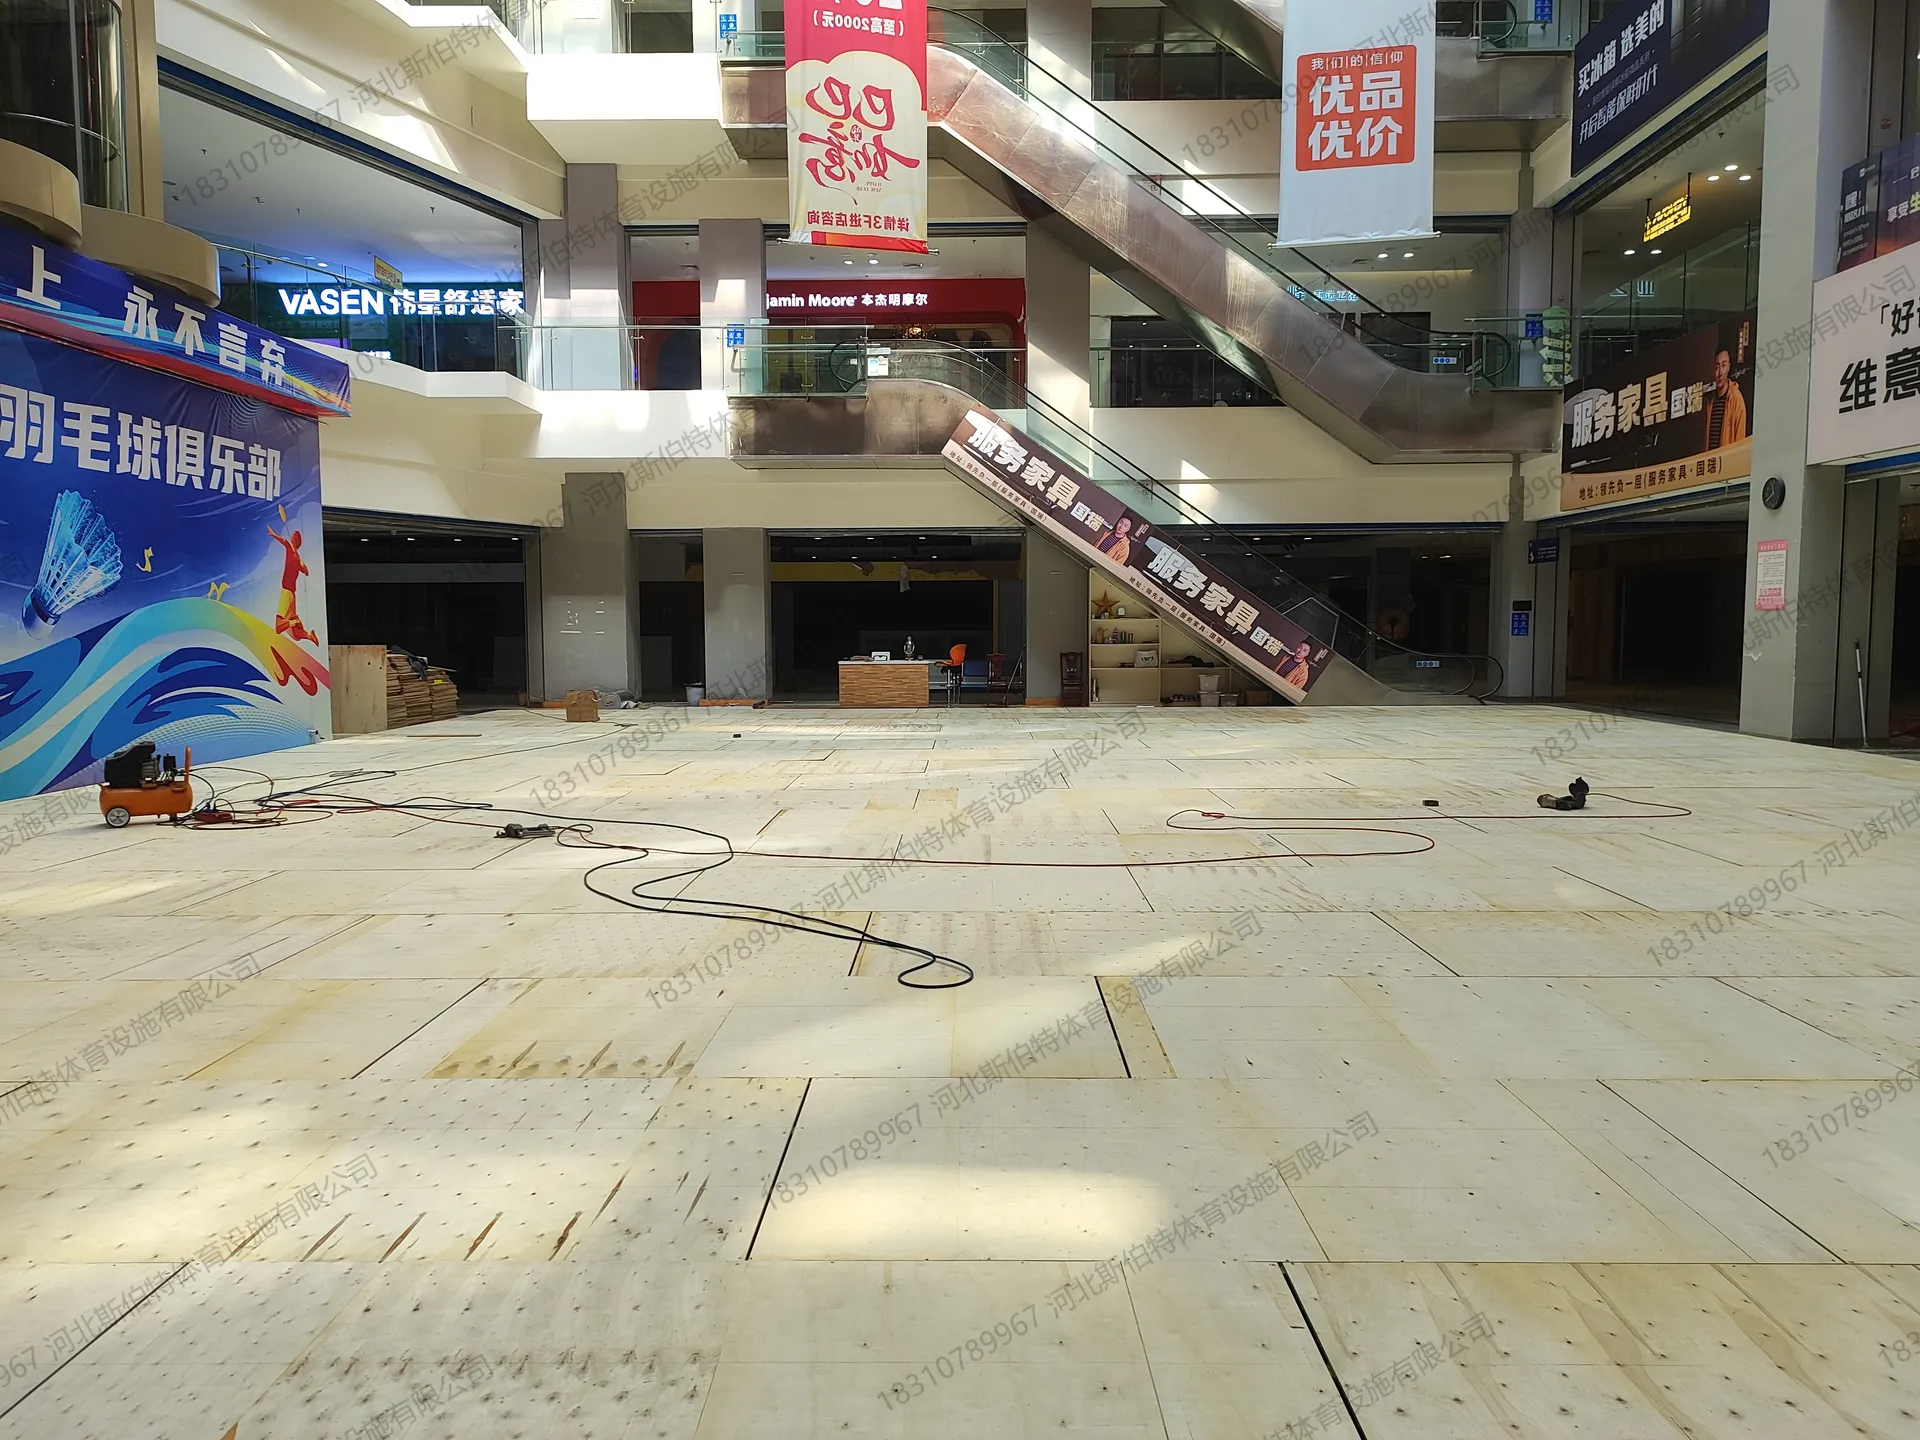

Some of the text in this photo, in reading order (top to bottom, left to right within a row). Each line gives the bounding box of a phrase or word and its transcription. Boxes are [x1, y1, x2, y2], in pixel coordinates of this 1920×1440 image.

[1578, 39, 1617, 97] 买冰箱
[1620, 0, 1665, 60] 选美的
[1308, 70, 1403, 116] 优品
[1579, 63, 1659, 145] 开启智能保鲜时代
[1308, 116, 1403, 161] 优价
[15, 244, 62, 310] 上
[122, 285, 286, 386] 永不言弃
[278, 287, 525, 317] VASEN 伟星舒适家
[765, 293, 928, 309] jamin Moore 本杰明摩尔
[1571, 371, 1668, 450] 服务家具
[1838, 345, 1920, 414] 维意
[0, 383, 282, 501] 羽毛球俱乐部
[967, 419, 1081, 511] 服务家具
[1147, 544, 1260, 635] 服务家具
